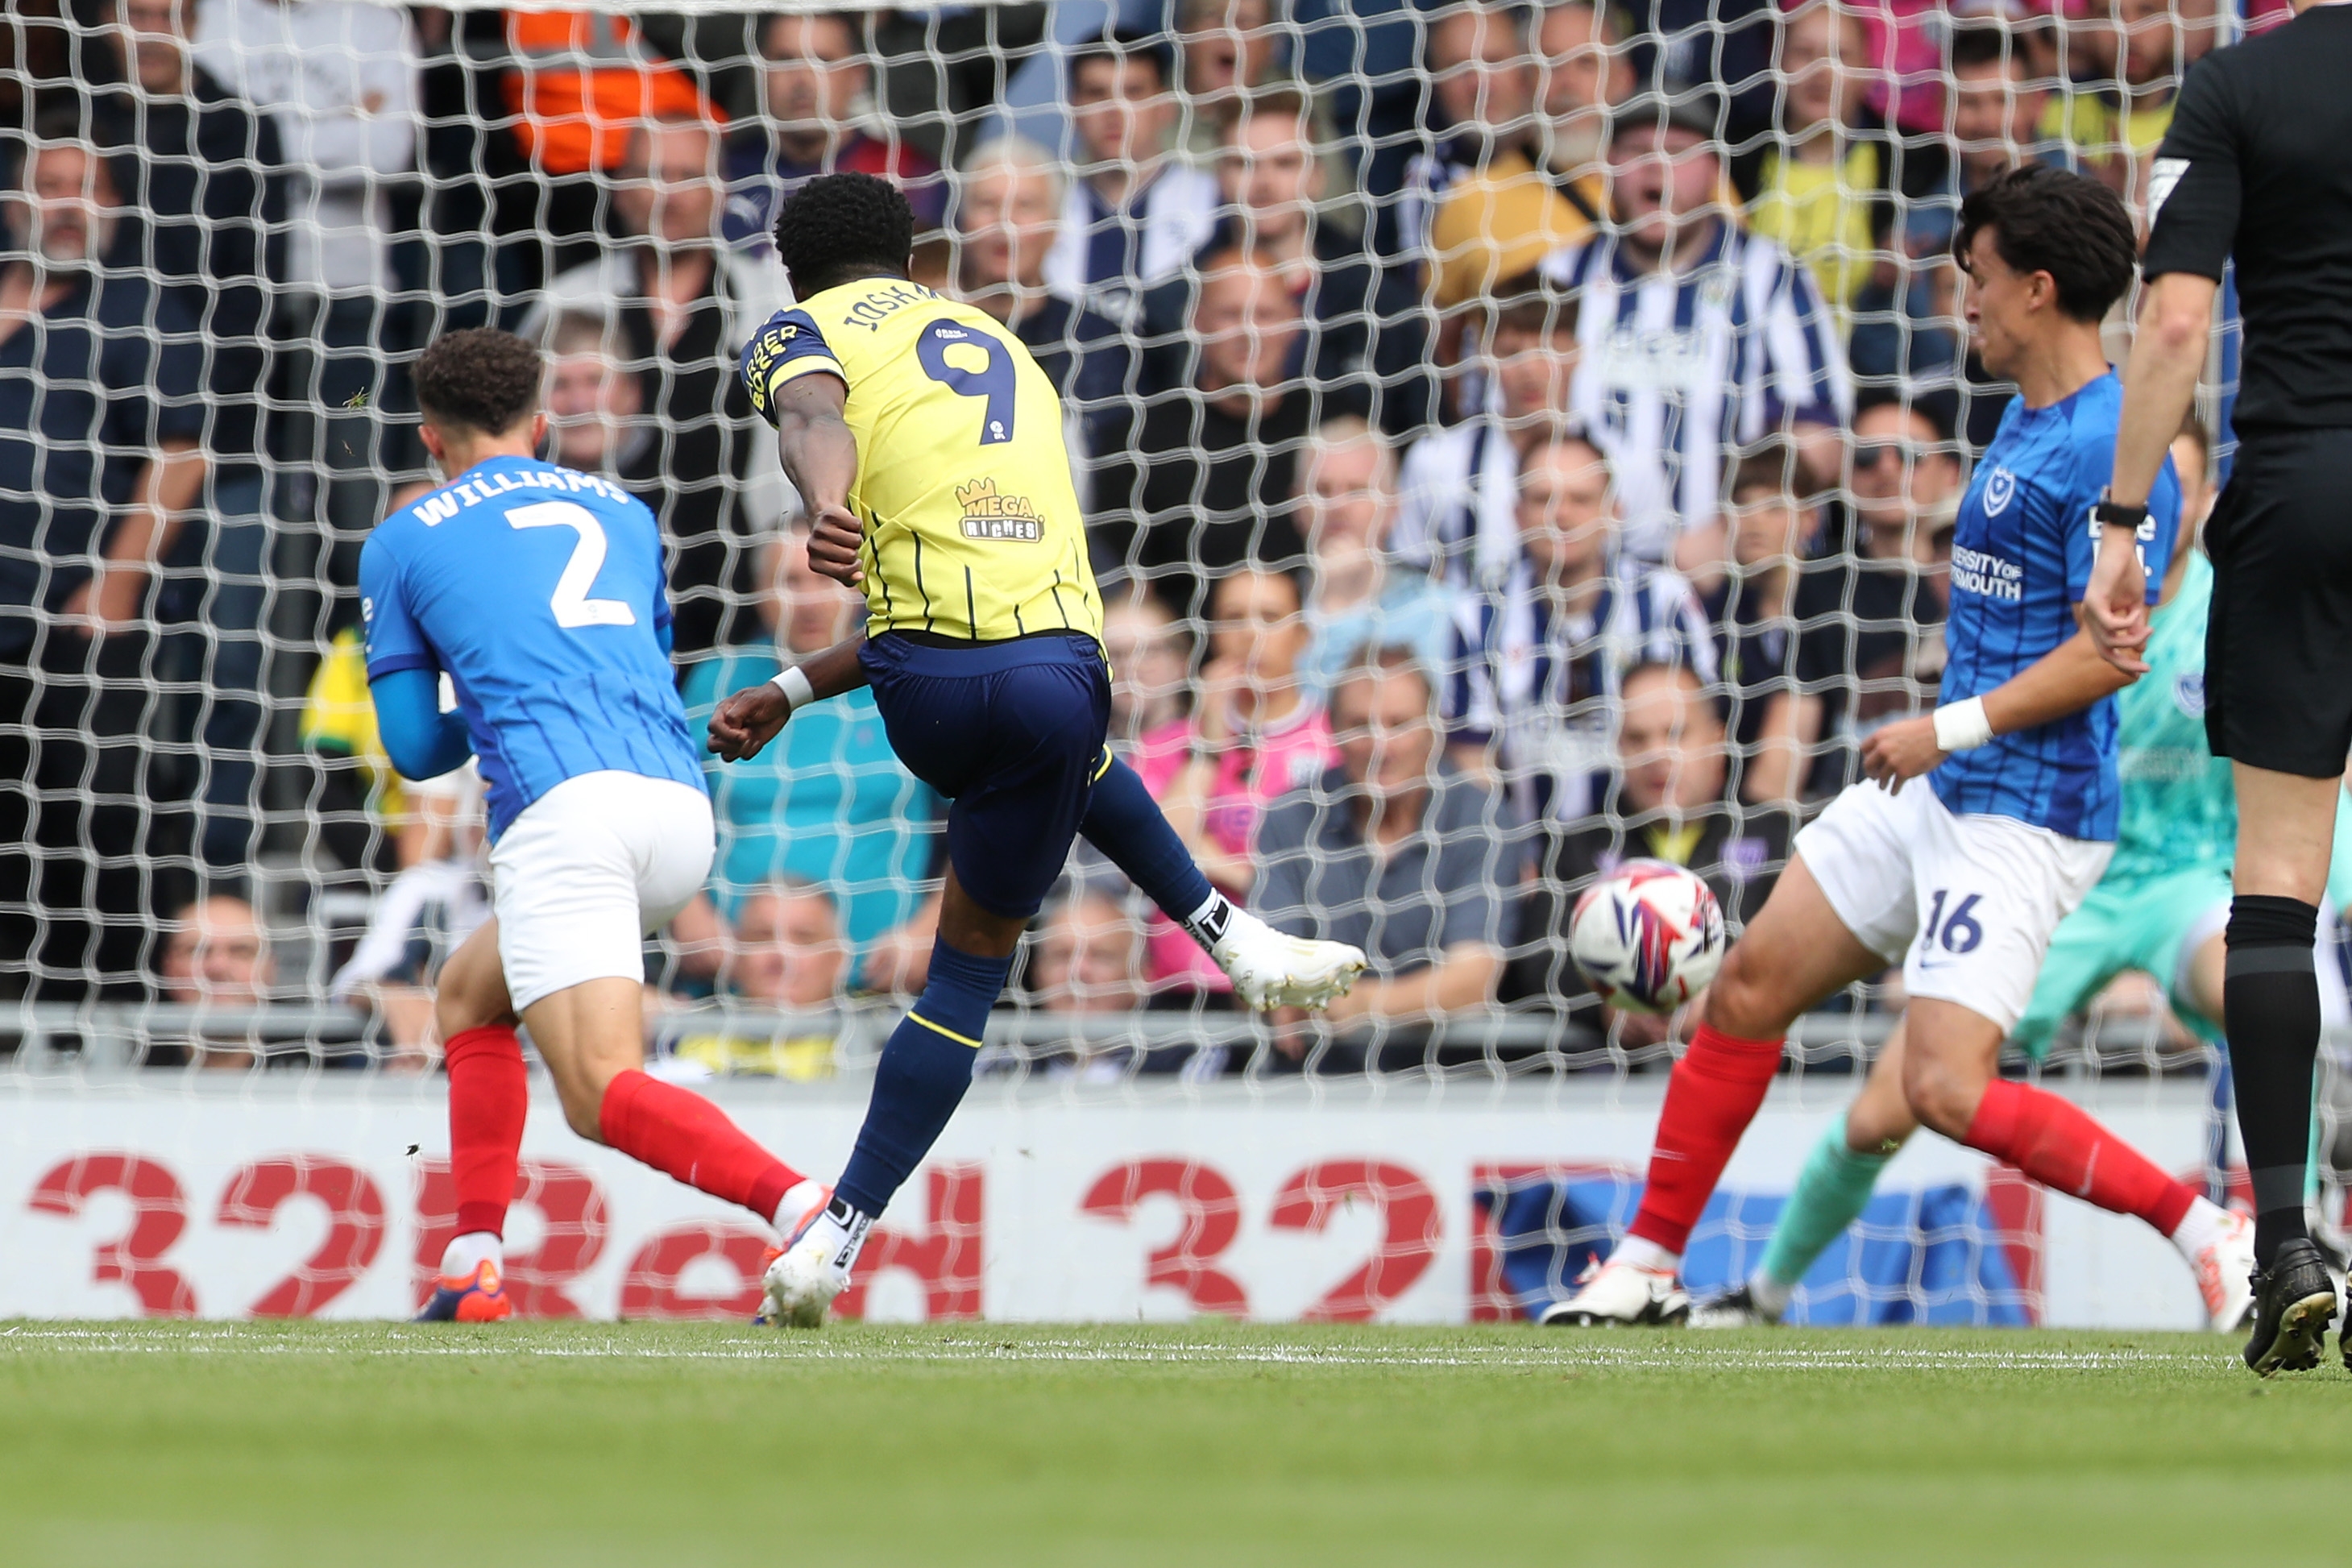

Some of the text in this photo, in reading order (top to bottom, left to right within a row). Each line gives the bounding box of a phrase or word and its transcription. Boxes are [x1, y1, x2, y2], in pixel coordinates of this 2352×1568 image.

[843, 285, 919, 332] JOSH
[916, 317, 1016, 446] 9
[412, 467, 630, 528] WILLIAMS
[965, 495, 1035, 517] MEGA
[966, 519, 1036, 539] RICHES
[503, 500, 637, 628] 2
[2001, 563, 2023, 581] OF
[1923, 890, 1983, 954] 16
[24, 1150, 985, 1321] 32Red
